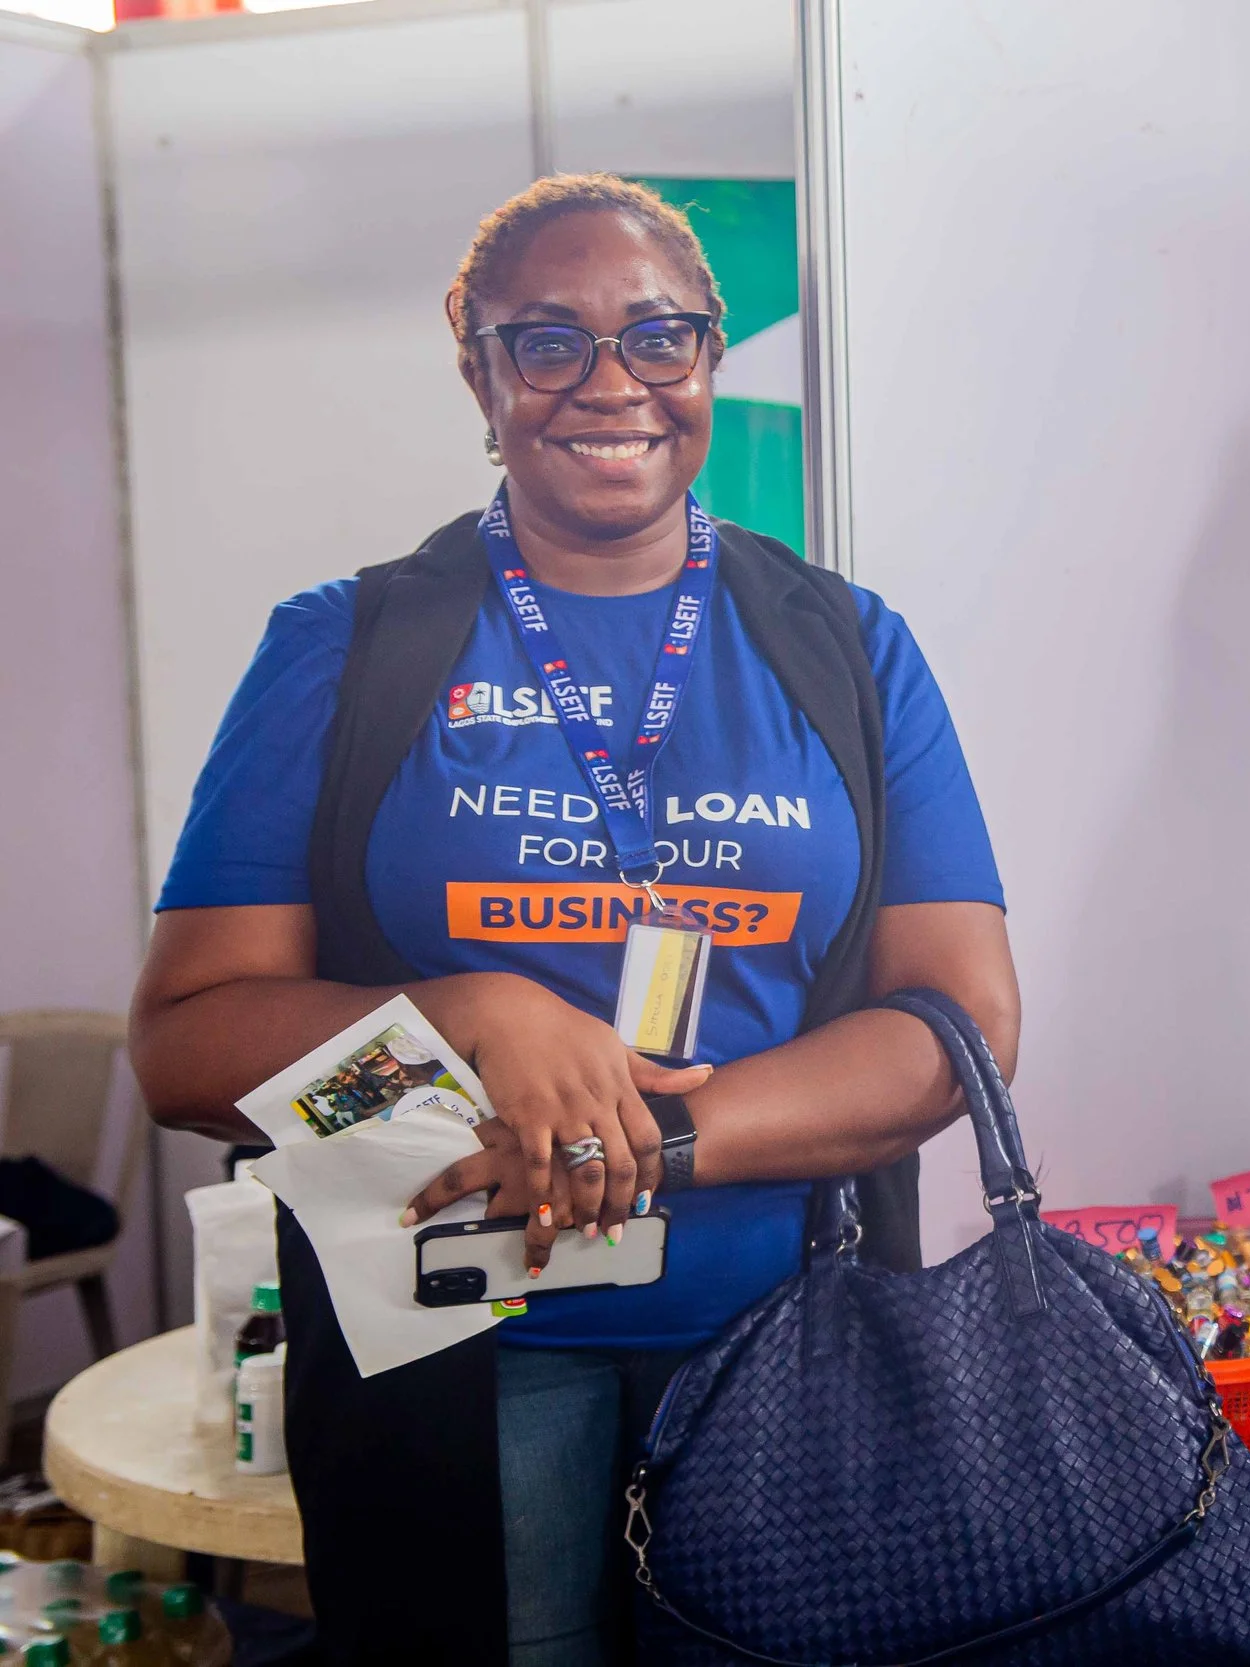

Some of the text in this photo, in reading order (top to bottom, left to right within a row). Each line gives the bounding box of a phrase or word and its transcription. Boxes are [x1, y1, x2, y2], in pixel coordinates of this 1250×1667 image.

[689, 505, 711, 553] LSETF
[509, 586, 548, 632] LSETF
[669, 594, 700, 640] LSETF
[448, 717, 476, 729] LAGOS
[476, 714, 502, 724] STATE
[550, 676, 589, 722] LSETF
[644, 682, 676, 729] LSETF
[450, 785, 811, 829] NEED LOAN
[592, 765, 631, 811] LSETF
[518, 835, 743, 870] FOR OUR
